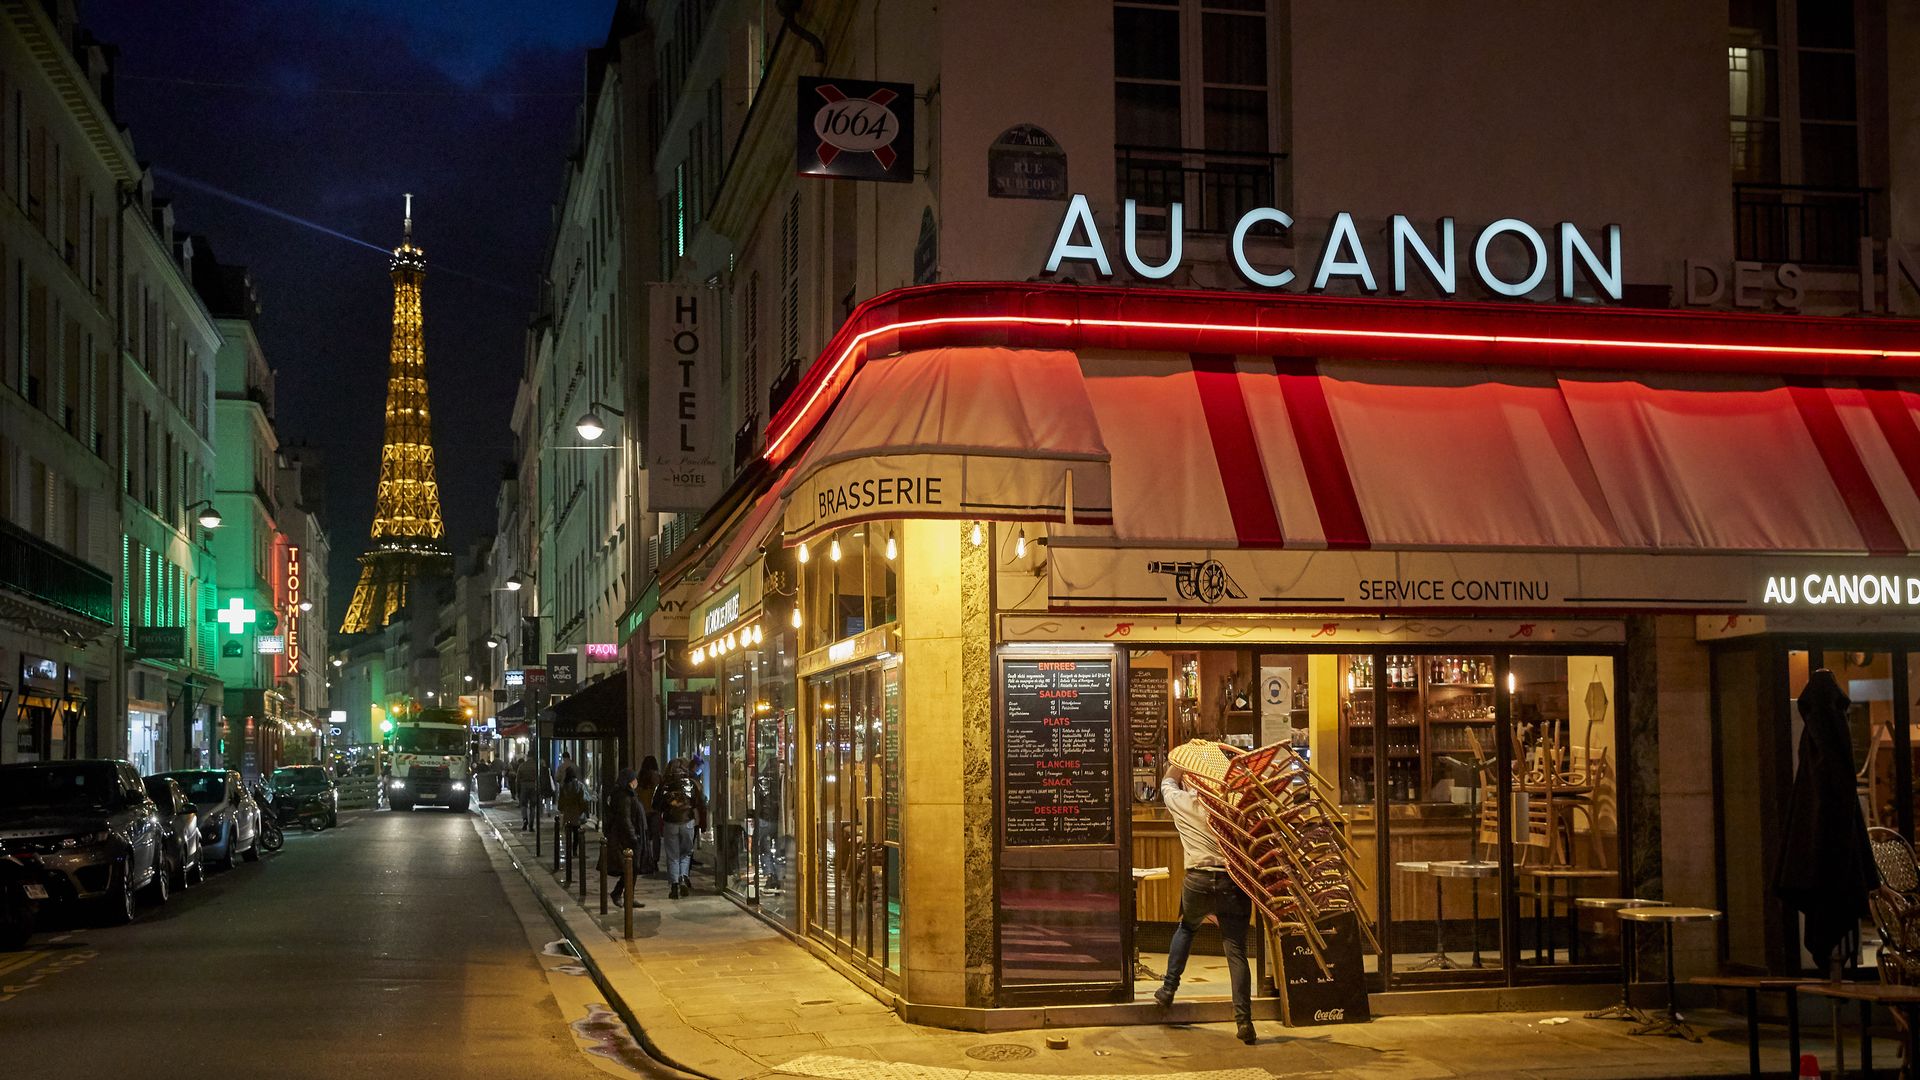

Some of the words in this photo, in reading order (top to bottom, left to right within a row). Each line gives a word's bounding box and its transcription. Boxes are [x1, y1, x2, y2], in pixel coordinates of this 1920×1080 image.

[823, 106, 888, 139] 1664
[1014, 161, 1043, 174] RUE
[1042, 193, 1183, 280] AU
[1230, 206, 1623, 301] CANON
[1685, 257, 1805, 309] DES
[674, 296, 699, 452] HOTEL
[673, 474, 706, 483] HOTEL
[818, 477, 942, 518] BRASSERIE
[1359, 580, 1444, 600] SERVICE
[1451, 580, 1549, 600] CONTINU
[1763, 576, 1797, 604] AU
[1802, 574, 1901, 605] CANON
[287, 547, 300, 673] THOUMIEUX
[259, 635, 282, 643] LAVERIE
[588, 643, 617, 655] PAON
[1038, 662, 1076, 671] ENTREES
[529, 675, 546, 683] SFR
[1039, 690, 1078, 699] SALADES
[1043, 717, 1071, 726] PLATS
[1036, 760, 1081, 769] PLANCHES
[1042, 778, 1073, 787] SNACK
[1034, 805, 1080, 815] DESSERTS
